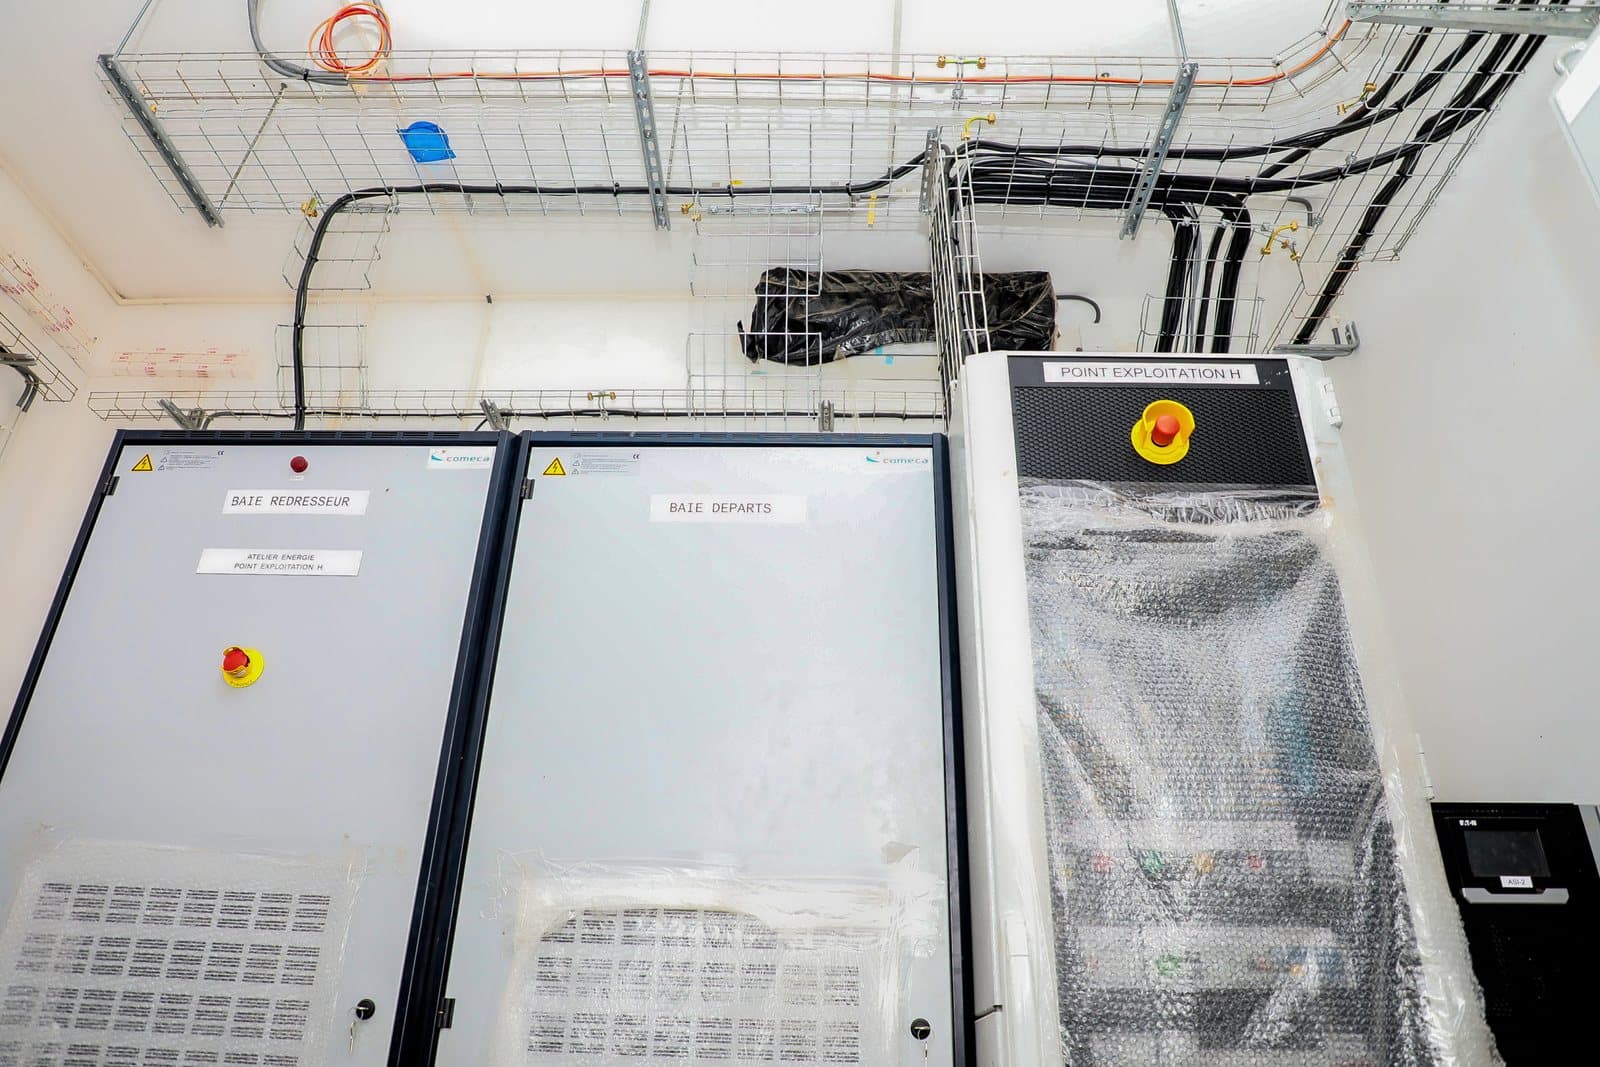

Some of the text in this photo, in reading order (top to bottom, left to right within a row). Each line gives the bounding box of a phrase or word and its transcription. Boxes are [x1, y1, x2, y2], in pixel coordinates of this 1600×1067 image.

[1061, 367, 1241, 379] POINT EXPLOITATION H
[231, 496, 350, 507] BAIE REDRESSEUR
[669, 502, 772, 514] BAIE DEPARTS
[247, 553, 316, 561] ATELIER ENERGIE
[234, 562, 257, 570] POINT
[260, 563, 314, 571] EXPLOITATION
